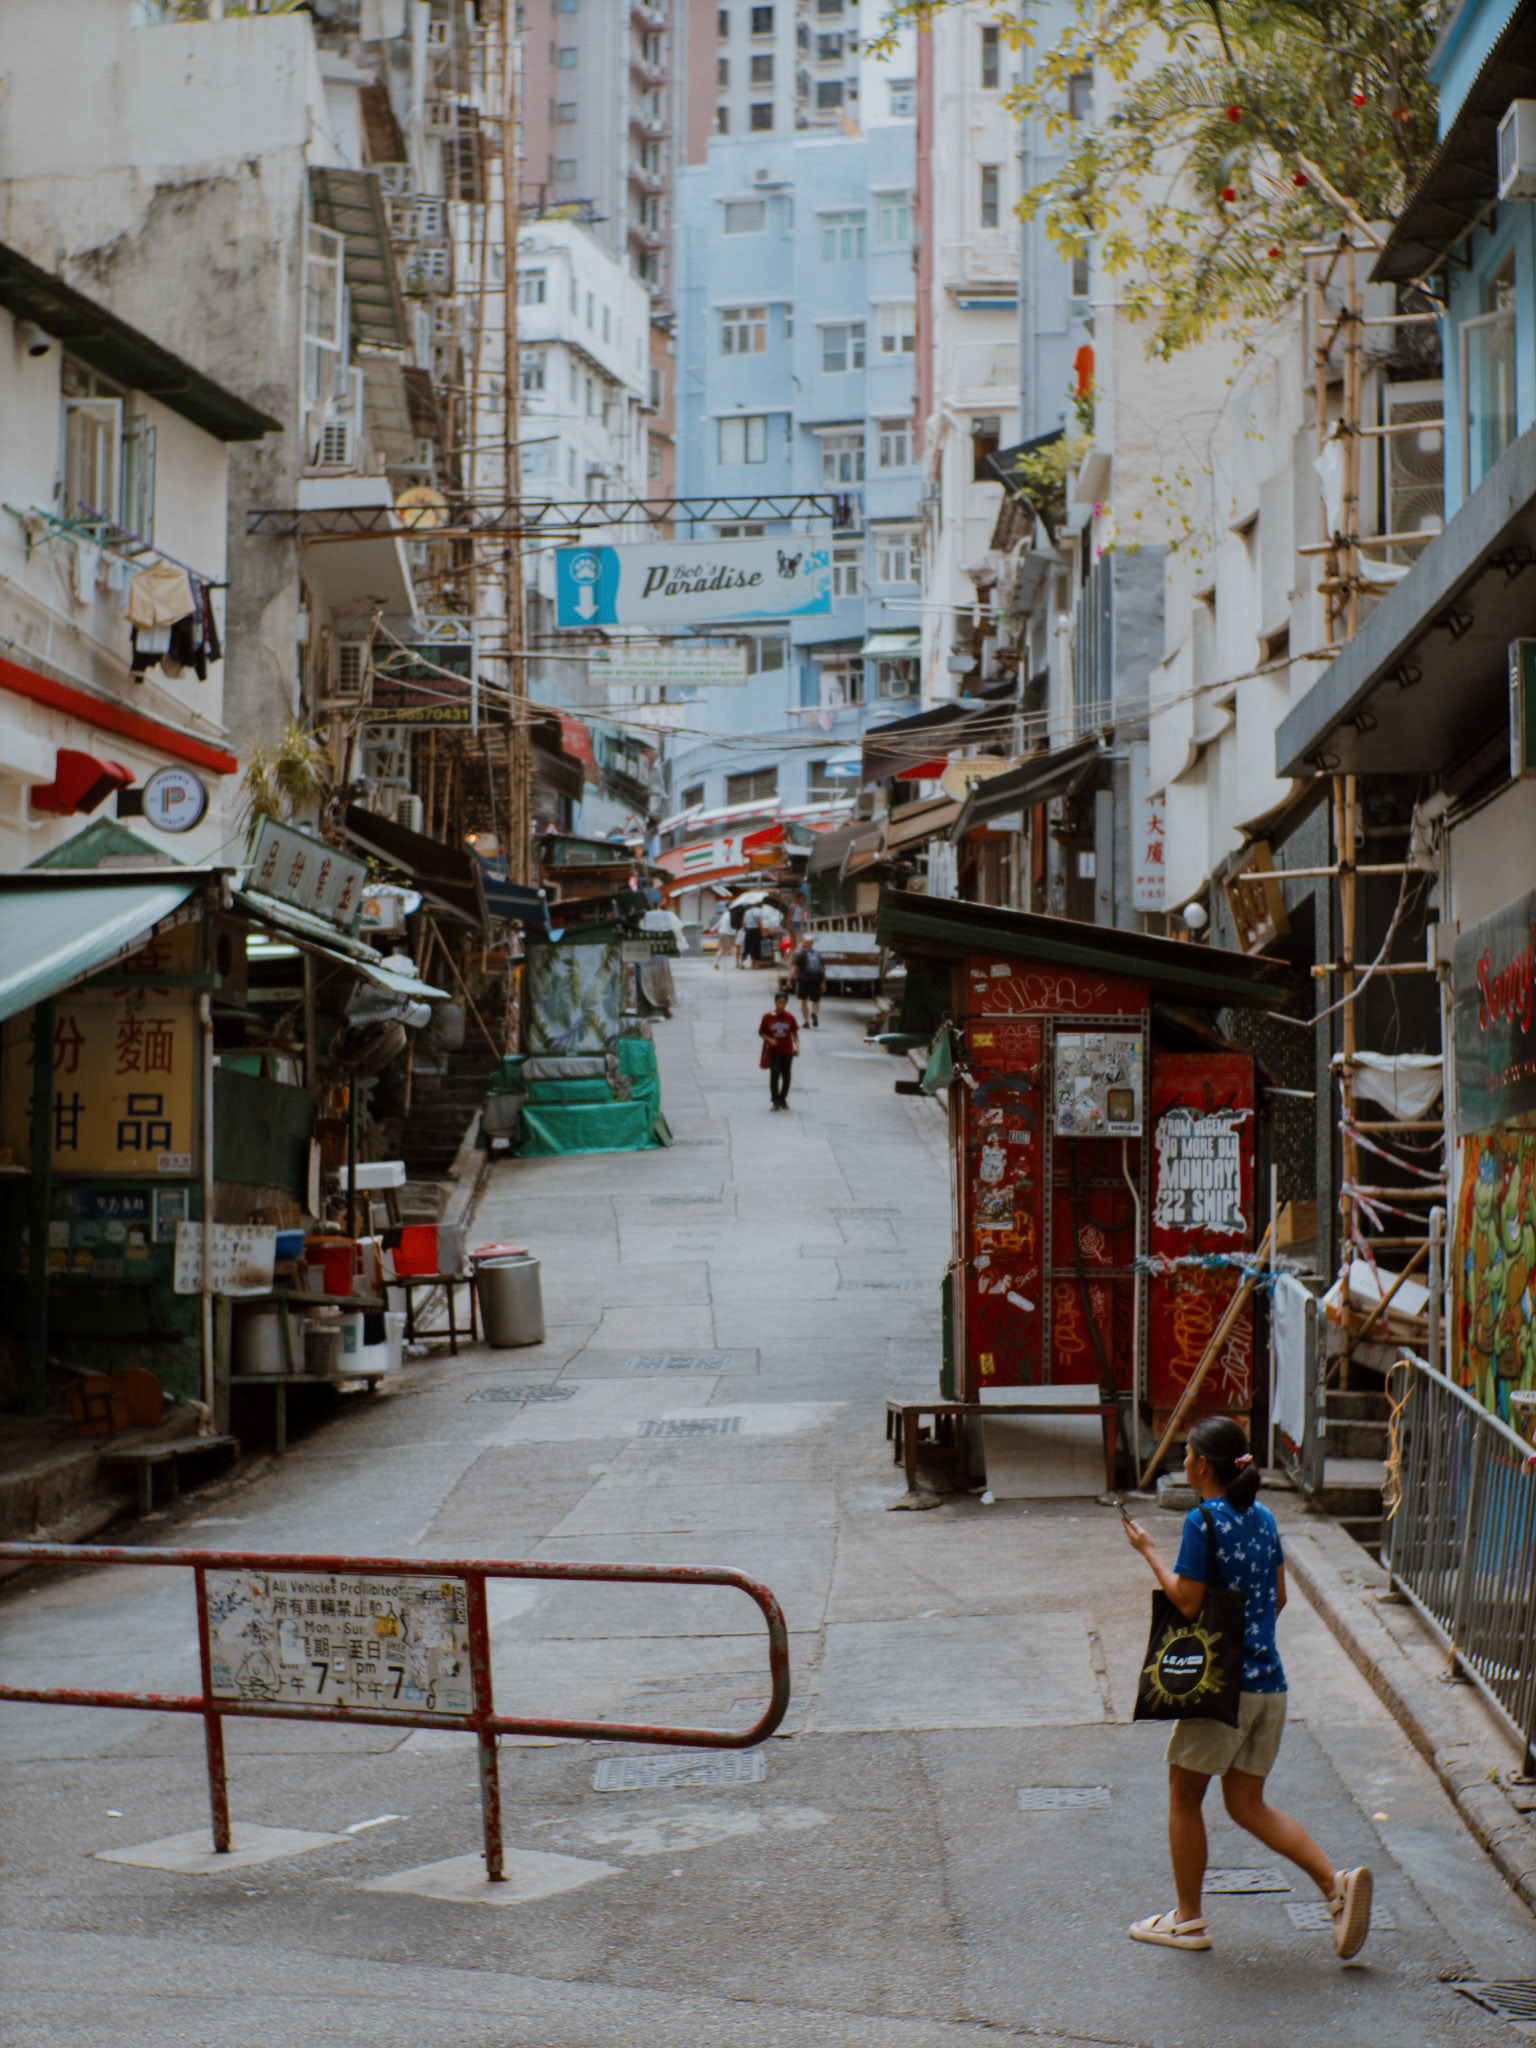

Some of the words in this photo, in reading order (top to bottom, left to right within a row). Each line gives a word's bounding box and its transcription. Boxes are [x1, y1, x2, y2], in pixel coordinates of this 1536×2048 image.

[673, 562, 717, 580] Bob's
[641, 565, 764, 599] Paradise
[1181, 1137, 1215, 1158] MORE
[1160, 1158, 1240, 1190] MONDAY
[1160, 1189, 1186, 1222] 22
[273, 1580, 288, 1593] All
[290, 1581, 338, 1595] Vehicles
[341, 1582, 399, 1597] Probited
[304, 1620, 334, 1634] Mon.
[356, 1661, 377, 1676] pm
[311, 1661, 329, 1695] 7
[387, 1665, 404, 1699] 7
